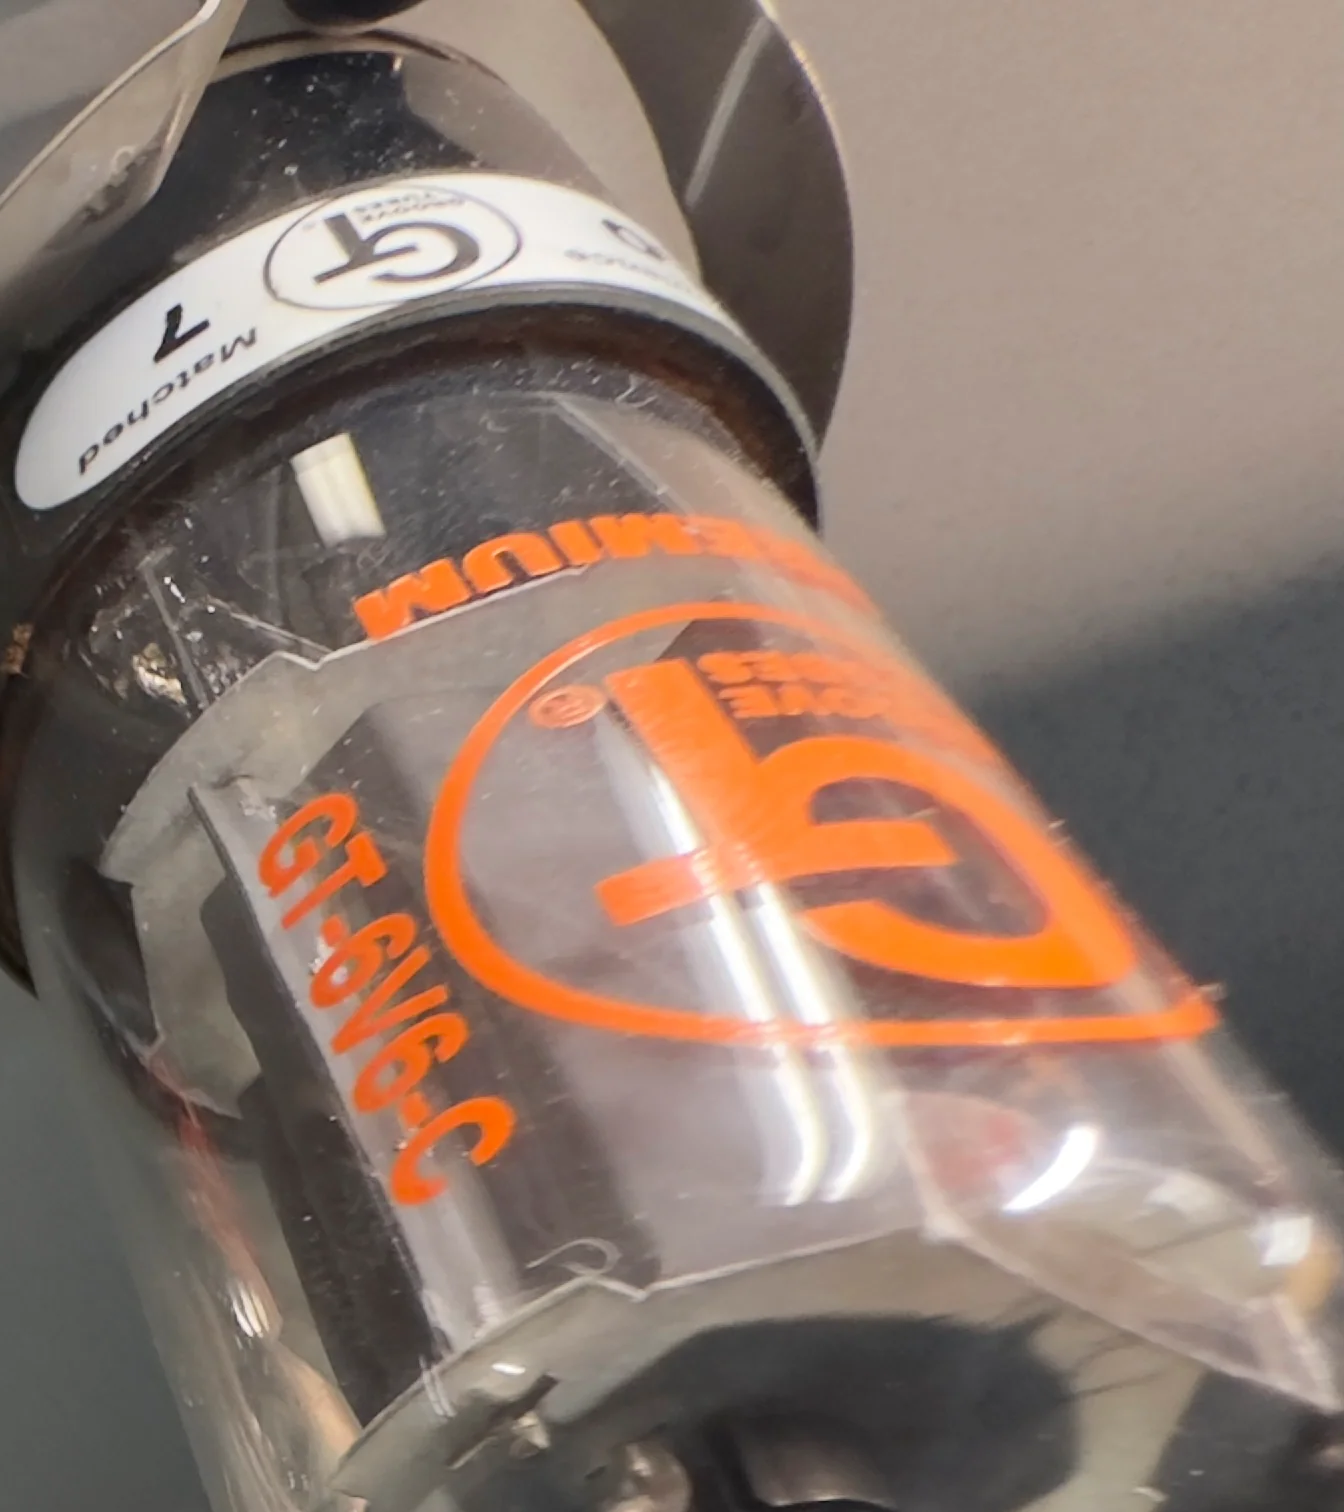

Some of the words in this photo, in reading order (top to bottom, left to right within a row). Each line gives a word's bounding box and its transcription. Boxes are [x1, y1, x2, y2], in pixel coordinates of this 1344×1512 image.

[311, 207, 481, 286] GT
[75, 326, 259, 477] Matched
[152, 302, 211, 363] 7
[592, 657, 1137, 990] GT
[256, 791, 517, 1206] GT-6V6-C
